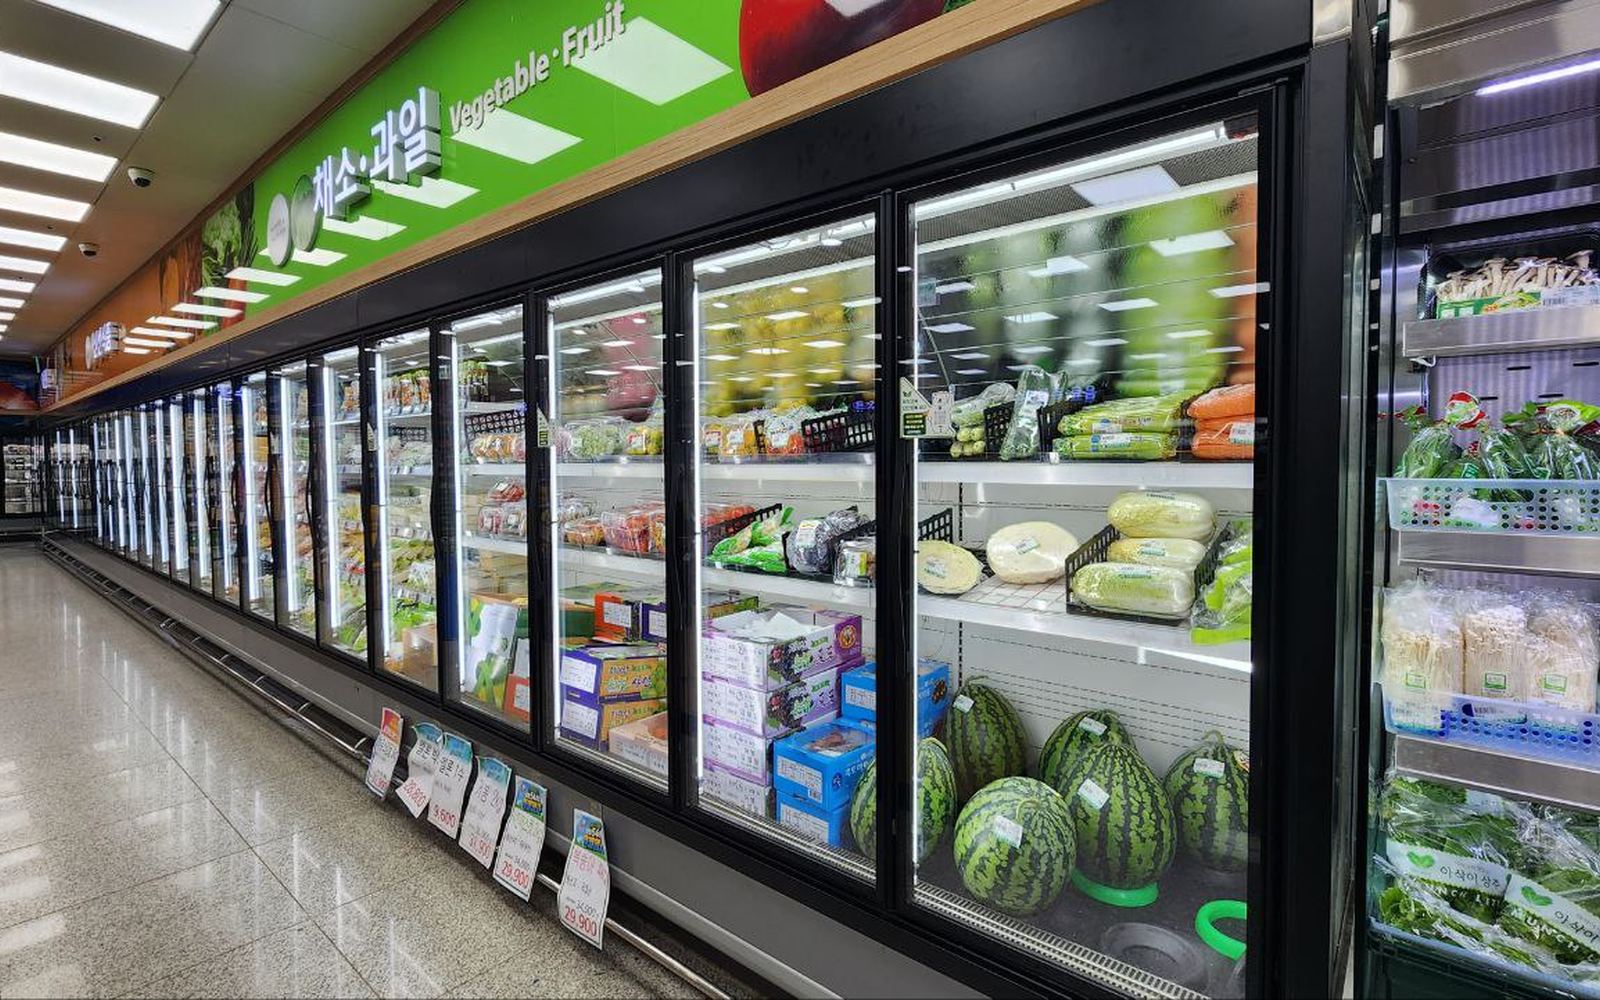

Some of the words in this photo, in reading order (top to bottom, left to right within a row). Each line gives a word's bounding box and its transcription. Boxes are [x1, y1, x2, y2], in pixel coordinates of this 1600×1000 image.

[313, 86, 434, 217] 채소·과일
[1440, 866, 1478, 885] 아삭이
[1482, 875, 1500, 889] 상추
[1555, 910, 1599, 943] 아삭이
